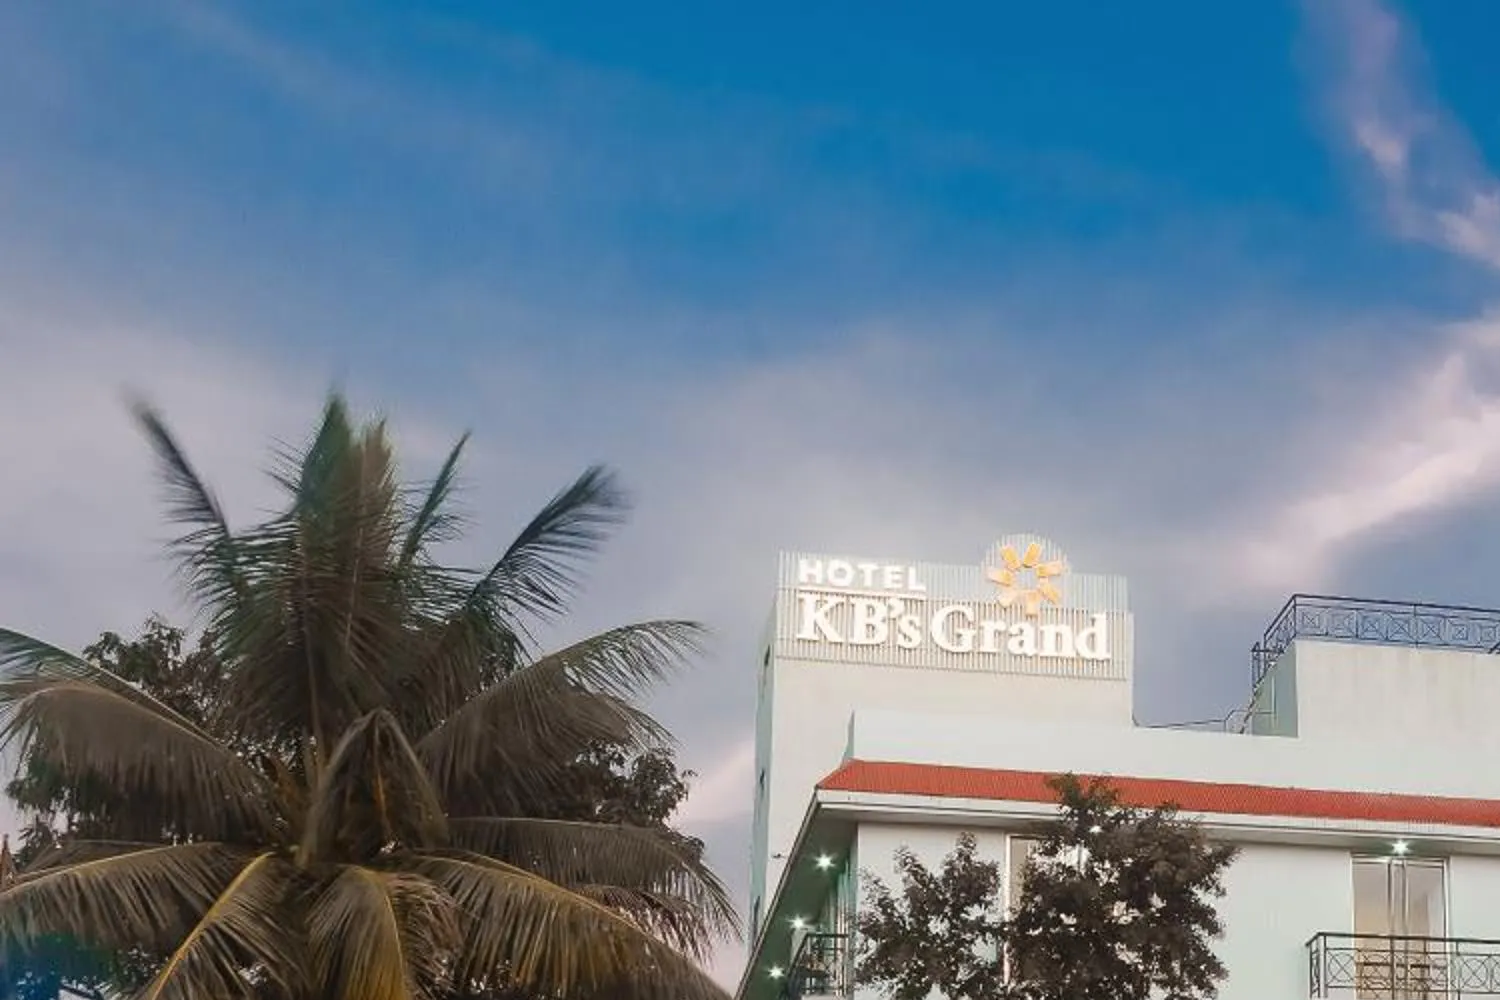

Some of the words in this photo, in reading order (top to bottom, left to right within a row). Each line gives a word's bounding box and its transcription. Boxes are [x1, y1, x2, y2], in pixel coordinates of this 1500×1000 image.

[799, 558, 926, 592] HOTEL
[797, 594, 922, 650] KB's
[930, 603, 1112, 662] Grand
